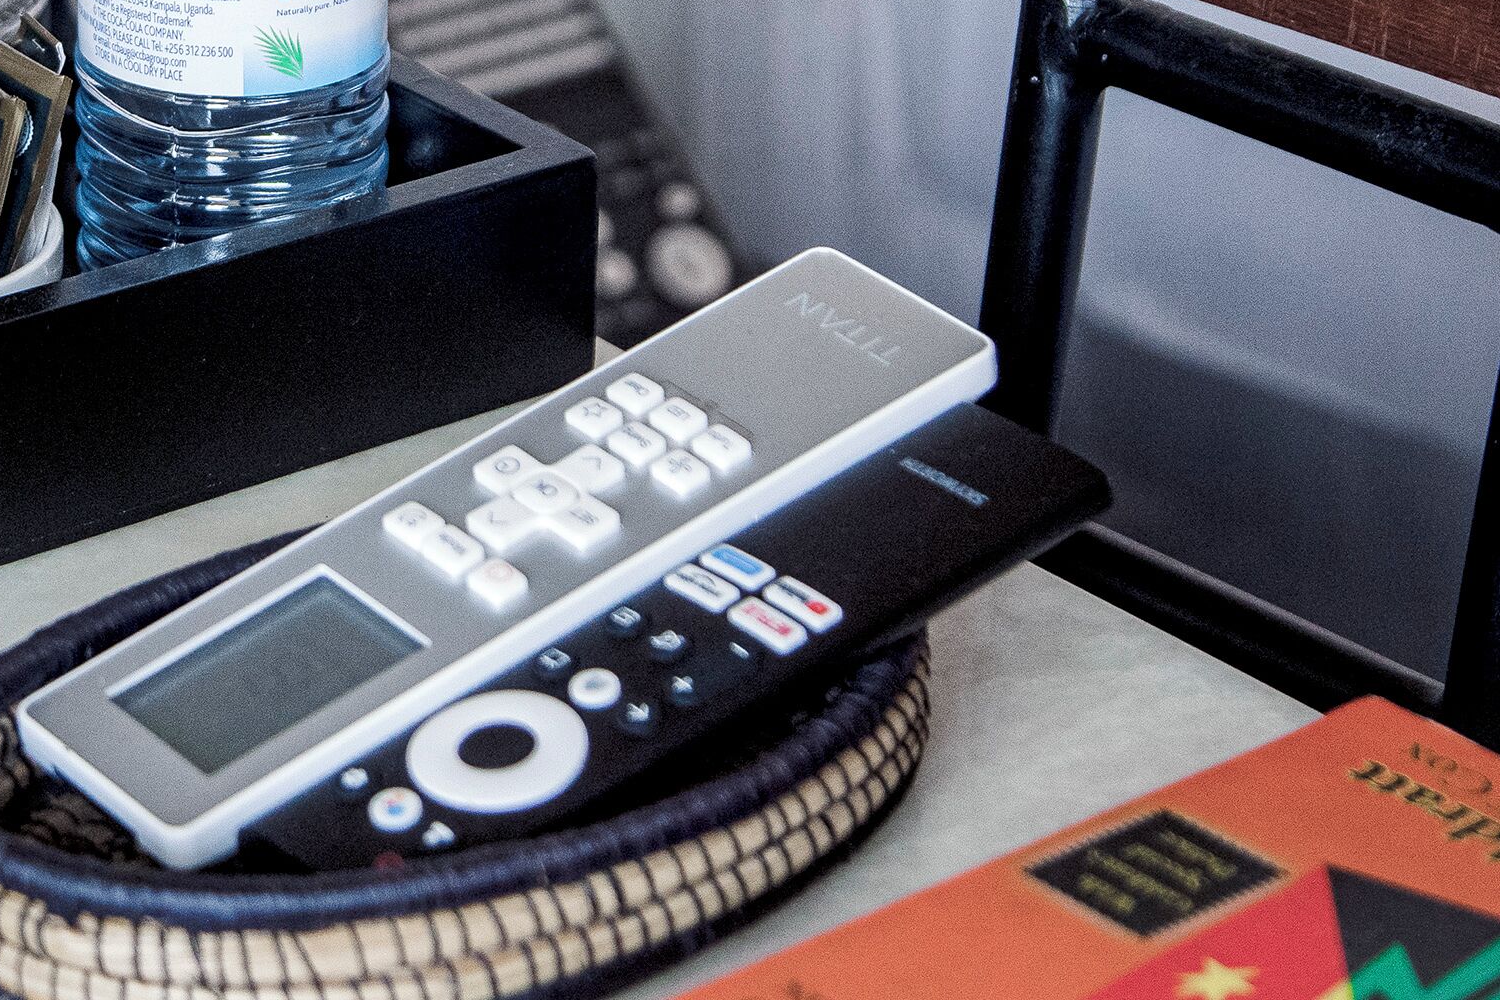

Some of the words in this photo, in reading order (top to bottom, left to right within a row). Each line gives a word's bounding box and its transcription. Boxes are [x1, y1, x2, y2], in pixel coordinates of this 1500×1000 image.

[120, 3, 152, 22] Registered
[152, 11, 193, 28] Trademark.
[183, 2, 215, 17] Uganda.
[276, 4, 313, 17] Naturally
[314, 1, 332, 13] pure.
[97, 6, 107, 21] THE
[107, 12, 143, 34] COCA-COLA
[144, 24, 186, 41] COMPANY.
[112, 28, 134, 45] PLEASE
[134, 35, 150, 50] CALL
[164, 42, 184, 55] +256
[185, 44, 200, 57] 312
[201, 45, 217, 57] 236
[218, 46, 234, 58] 500
[95, 44, 110, 63] STORE
[110, 53, 118, 65] IN
[123, 58, 144, 74] COOL
[143, 64, 159, 77] DRY
[159, 67, 183, 81] PLACE
[785, 291, 901, 368] TITAN
[534, 478, 559, 498] OK
